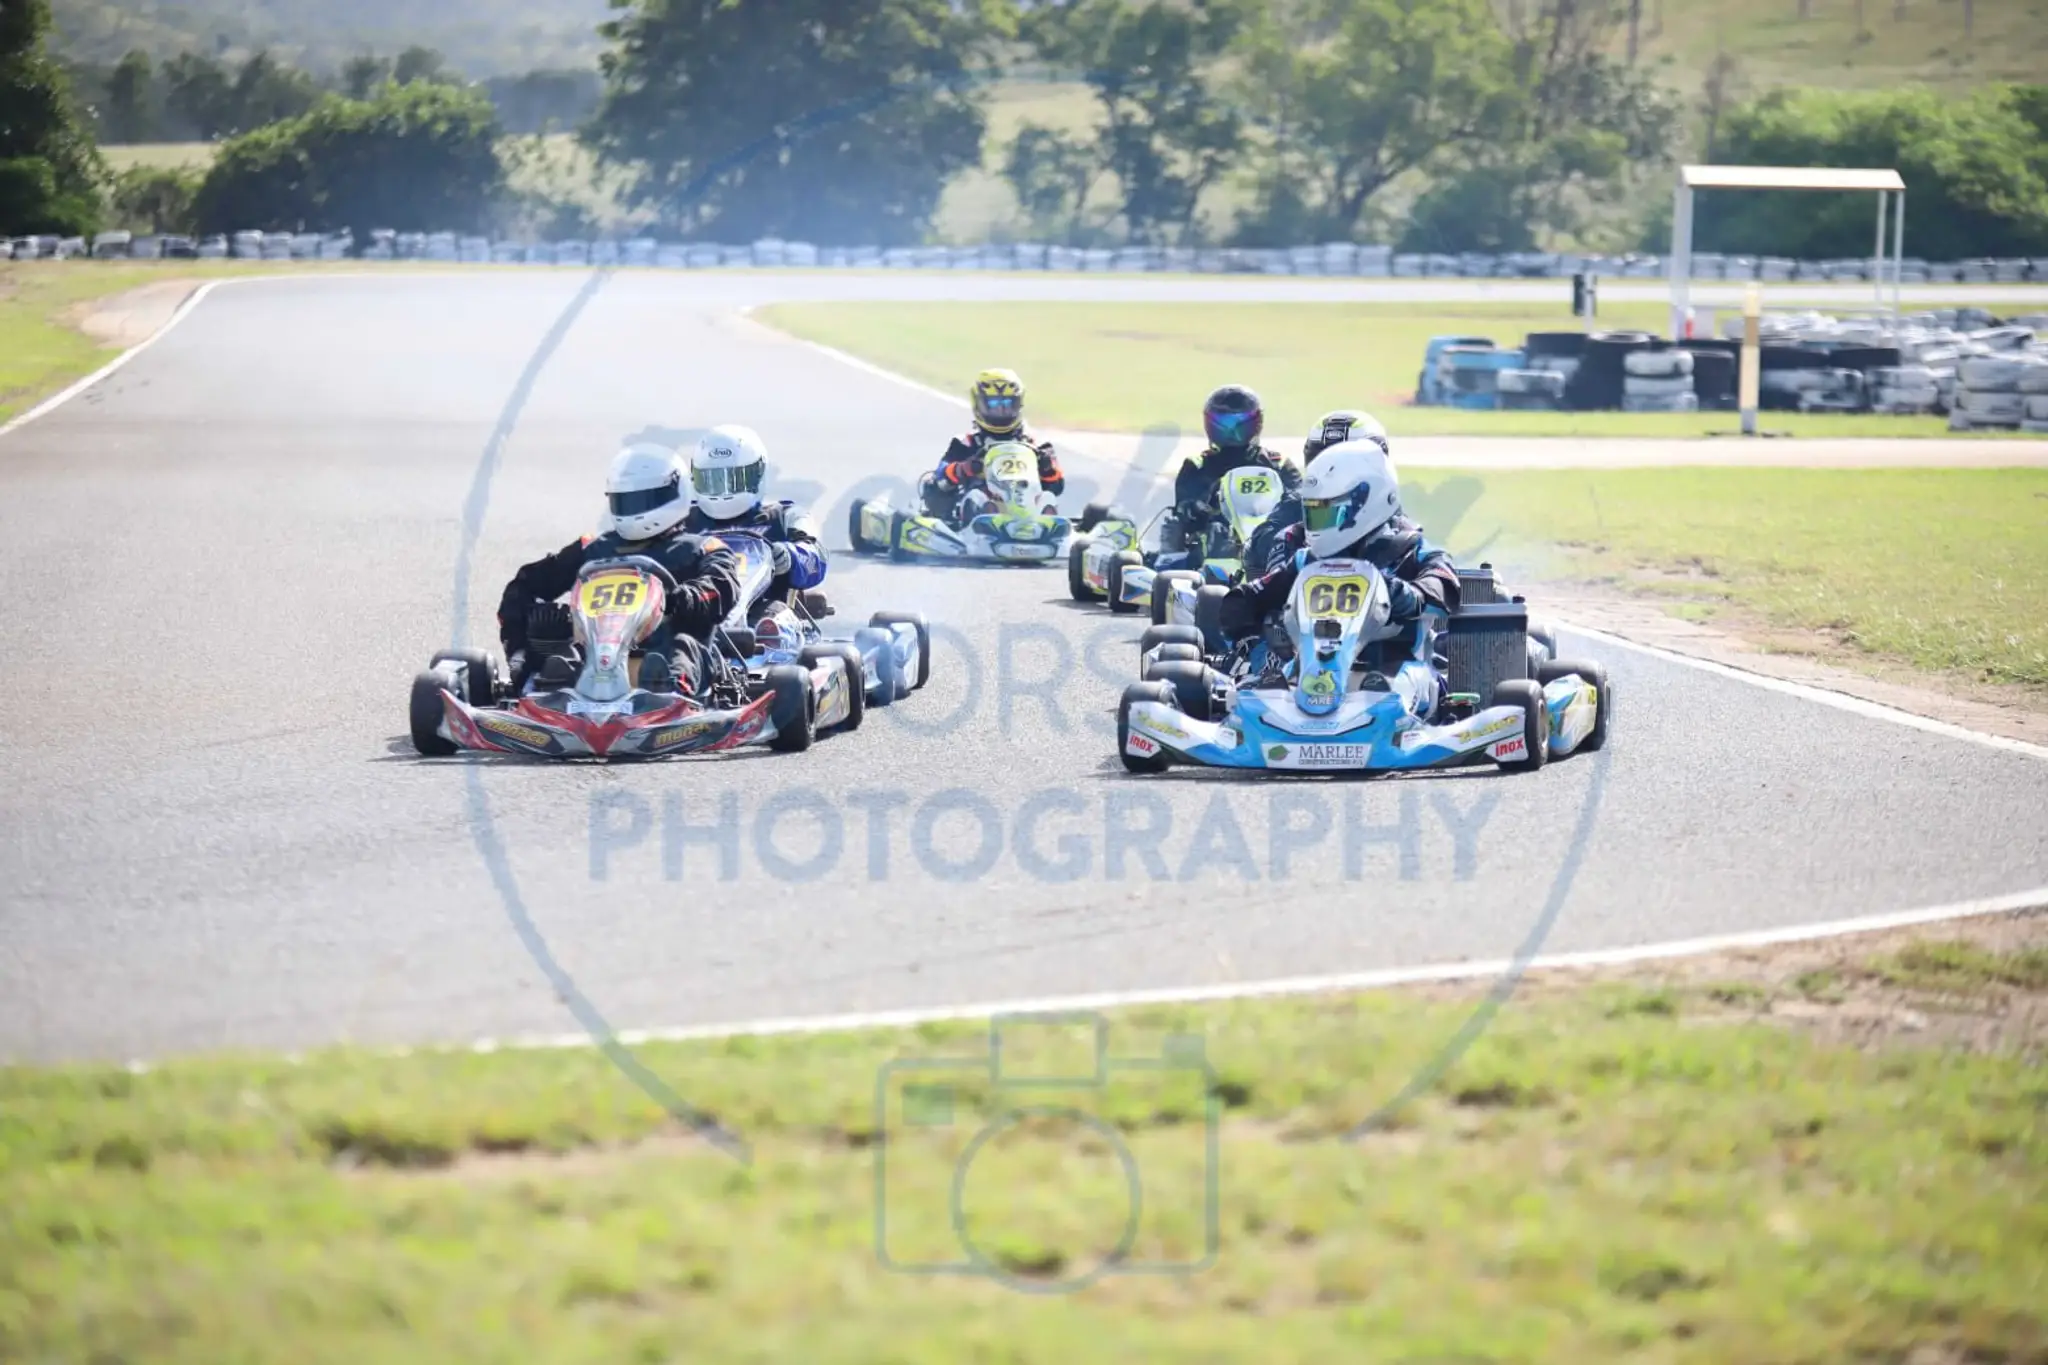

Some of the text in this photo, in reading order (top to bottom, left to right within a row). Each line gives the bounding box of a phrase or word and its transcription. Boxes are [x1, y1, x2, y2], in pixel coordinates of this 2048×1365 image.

[590, 582, 637, 610] 56
[1309, 582, 1361, 614] 66
[1130, 734, 1154, 753] inox
[1299, 744, 1364, 759] MARLEE
[1494, 737, 1524, 757] inox
